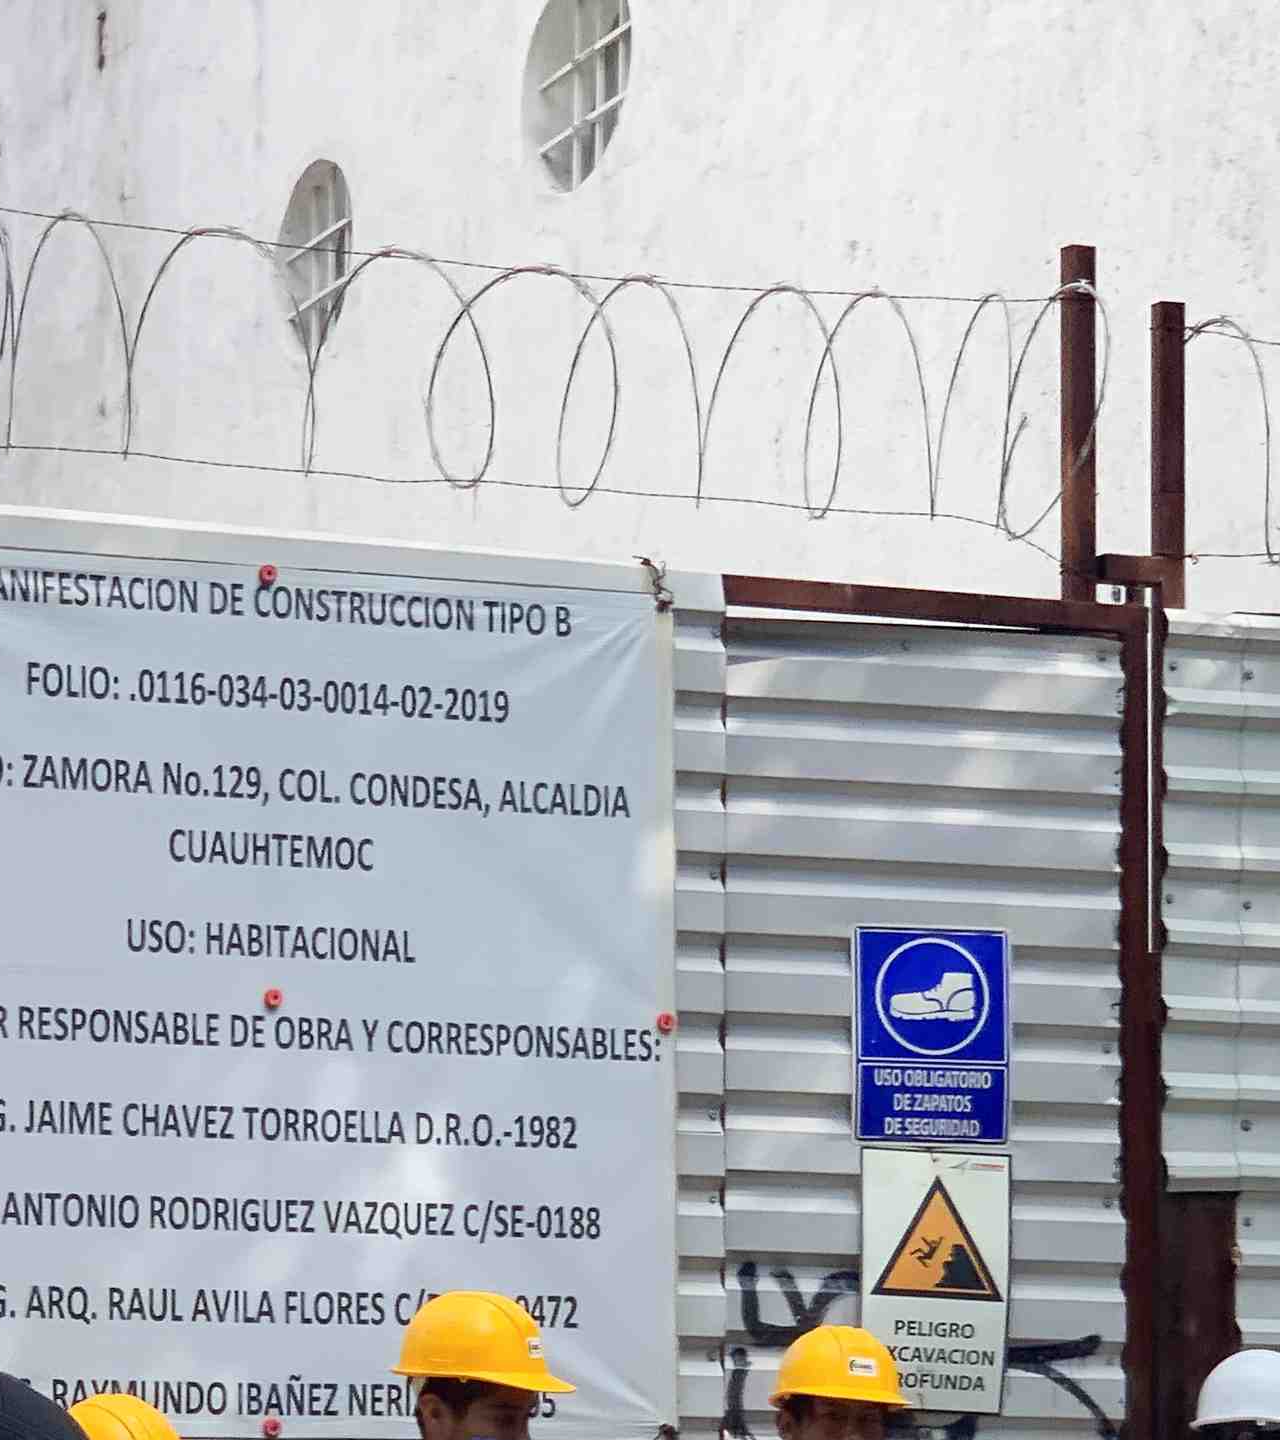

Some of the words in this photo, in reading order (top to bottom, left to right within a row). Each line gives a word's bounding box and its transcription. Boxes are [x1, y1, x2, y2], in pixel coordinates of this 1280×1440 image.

[210, 582, 243, 616] DE
[254, 584, 474, 631] CONSTRUCCION
[483, 601, 546, 635] TIPO
[556, 603, 571, 636] B
[27, 662, 118, 699] FOLIO:
[130, 669, 508, 722] .0116-034-03-0014-02-2019
[23, 754, 152, 793] ZAMORA
[163, 762, 268, 806] No.129,
[279, 768, 340, 803] COL.
[350, 772, 490, 817] CONDESA,
[499, 780, 630, 817] ALCALDIA
[170, 829, 373, 871] CUAUHTEMOC
[128, 919, 194, 953] USO:
[206, 922, 415, 963] HABITACIONAL
[19, 1006, 219, 1046] RESPONSABLE
[231, 1014, 264, 1047] DE
[274, 1015, 353, 1050] OBRA
[362, 1019, 378, 1051] Y
[388, 1020, 662, 1061] CORRESPONSABLES:
[874, 1068, 901, 1086] USO
[904, 1069, 992, 1089] OBLIGATORIO
[893, 1093, 913, 1112] DE
[913, 1094, 972, 1112] ZAPATOS
[24, 1100, 112, 1135] JAIME
[123, 1103, 234, 1139] CHAVEZ
[242, 1107, 405, 1143] TORROELLA
[416, 1112, 577, 1148] D.R.O.-1982
[884, 1117, 902, 1135] DE
[904, 1118, 980, 1137] SEGURIDAD
[2, 1192, 139, 1228] ANTONIO
[150, 1196, 314, 1232] RODRIGUEZ
[324, 1200, 454, 1239] VAZQUEZ
[464, 1200, 600, 1243] C/SE-0188
[25, 1286, 96, 1324] ARQ.
[109, 1287, 183, 1321] RAUL
[192, 1289, 275, 1323] AVILA
[285, 1291, 384, 1325] FLORES
[894, 1320, 975, 1339] PELIGRO
[887, 1345, 995, 1366] XCAVACION
[238, 1375, 338, 1416] IBAÑEZ
[348, 1384, 415, 1416] NERI
[897, 1372, 985, 1391] ROFUNDA
